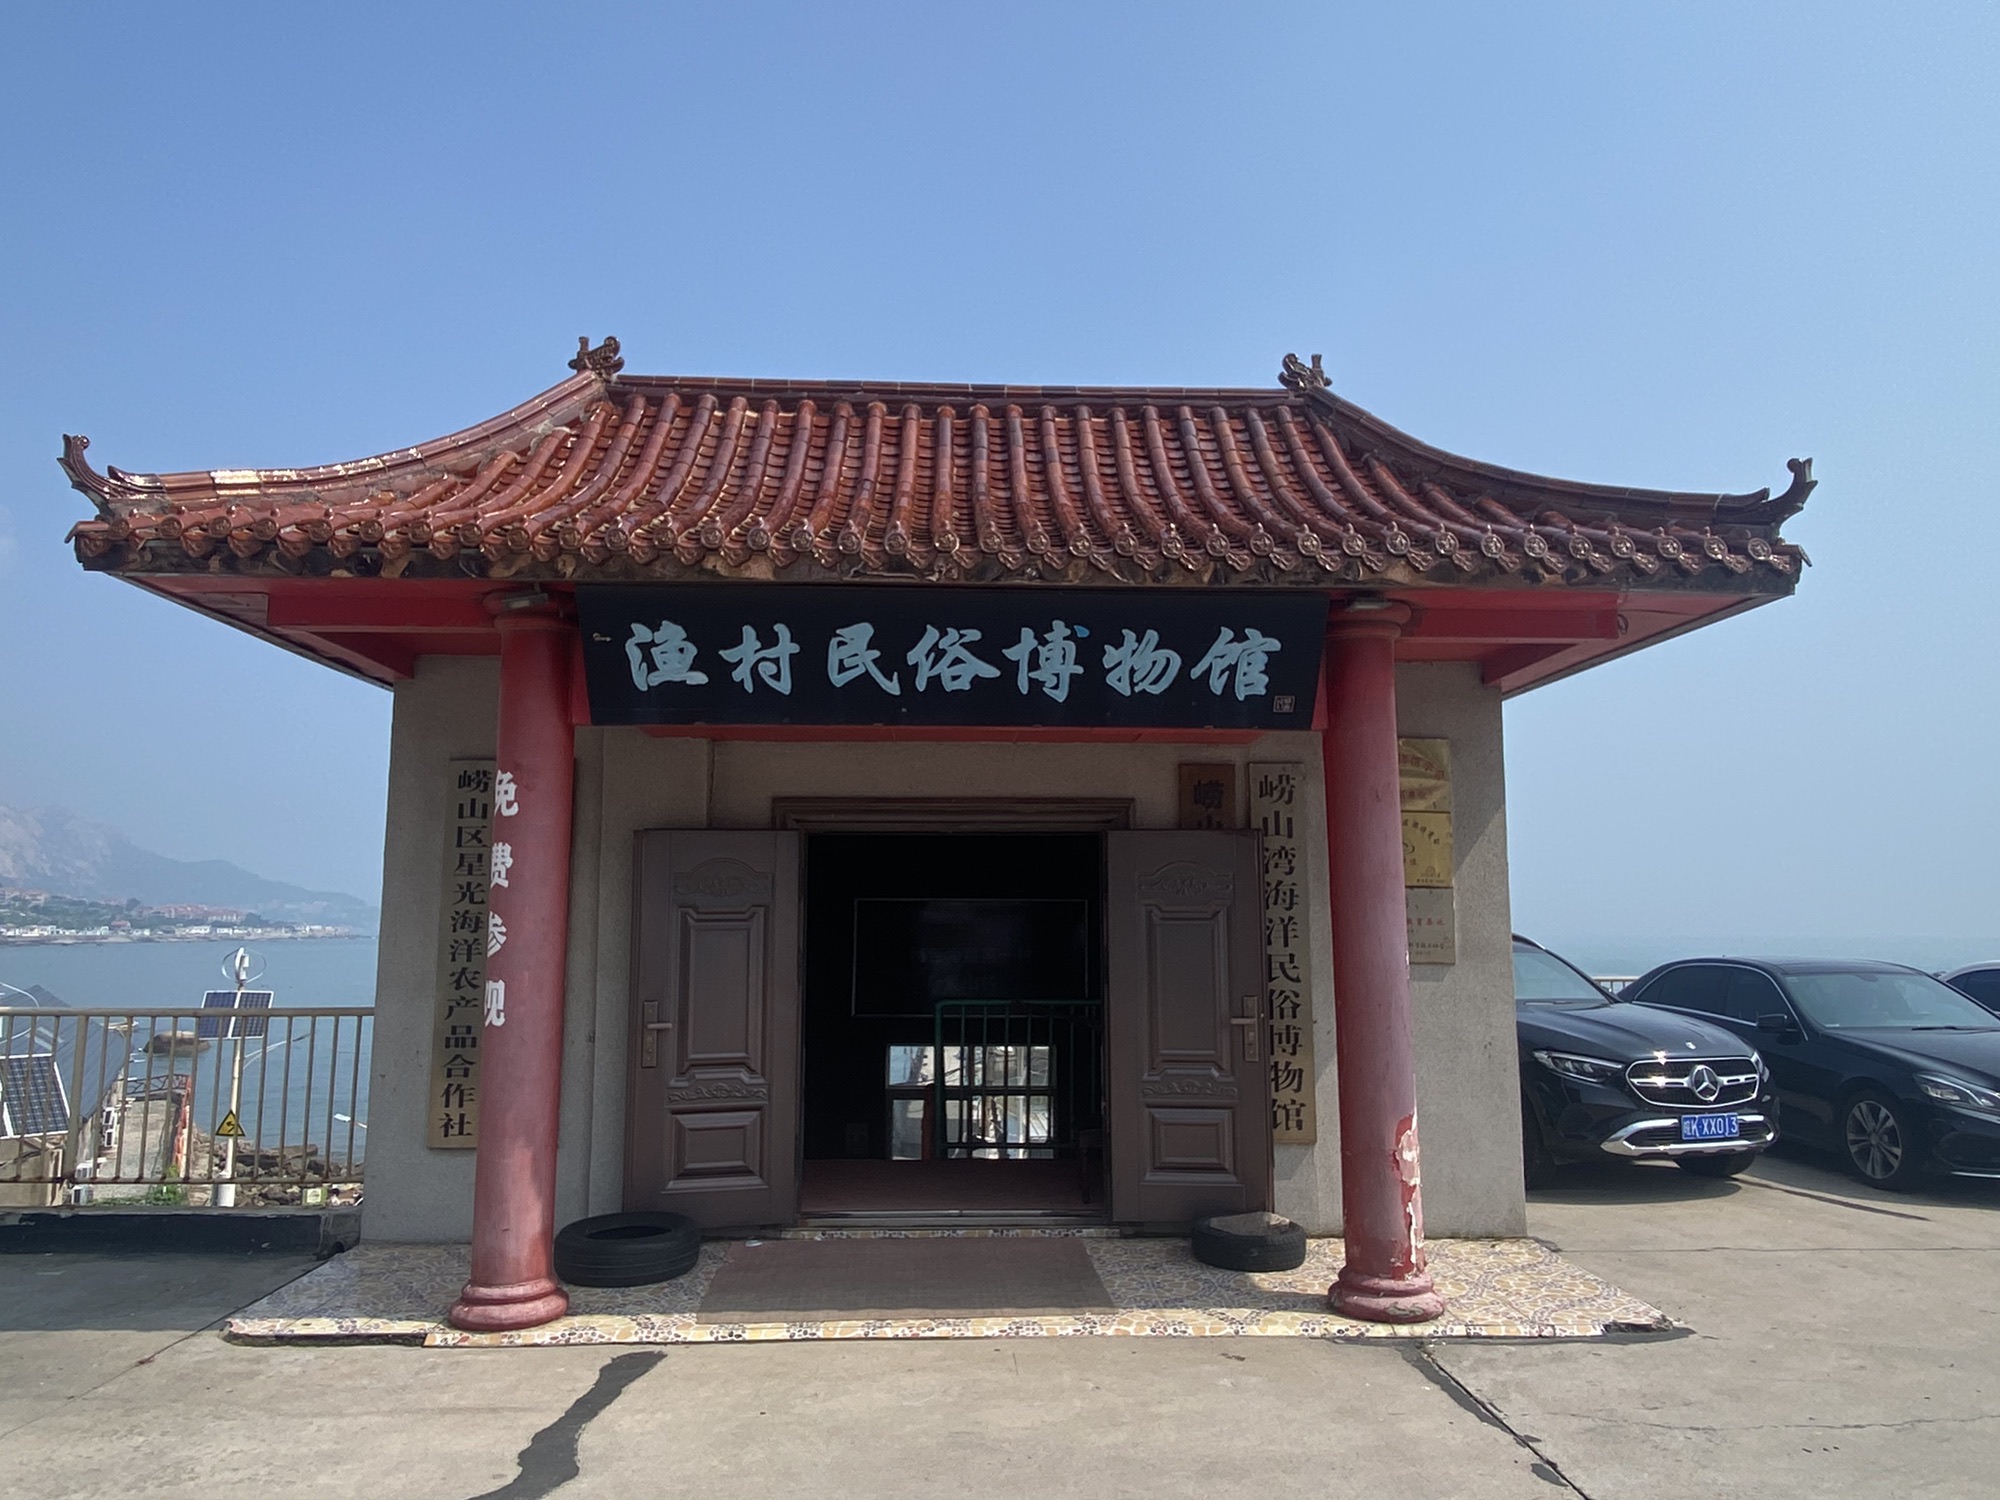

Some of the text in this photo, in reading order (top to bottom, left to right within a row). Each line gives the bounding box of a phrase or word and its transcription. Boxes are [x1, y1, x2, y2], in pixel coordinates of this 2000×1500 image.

[625, 620, 1283, 702] 渔村民俗博物馆
[438, 769, 492, 1138] 崂山区星光海洋农产品合作社
[1258, 773, 1306, 1131] 崂山湾海洋民俗博物馆
